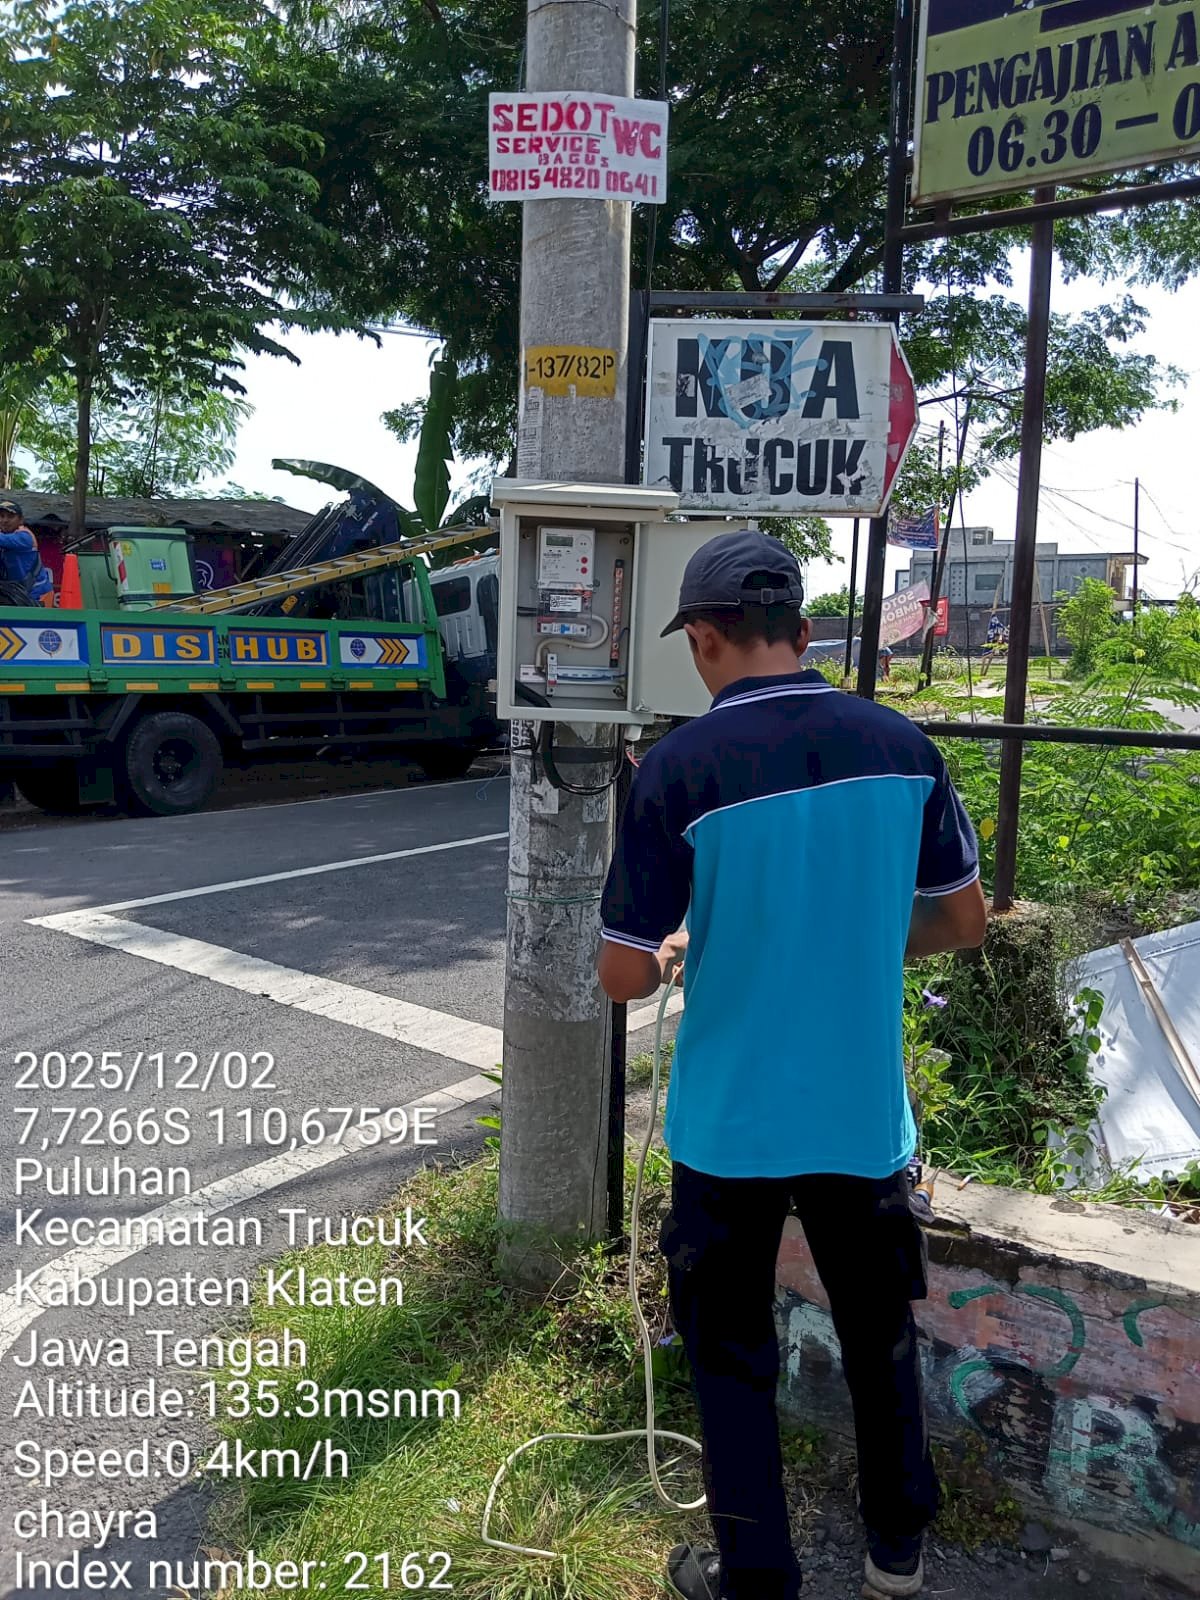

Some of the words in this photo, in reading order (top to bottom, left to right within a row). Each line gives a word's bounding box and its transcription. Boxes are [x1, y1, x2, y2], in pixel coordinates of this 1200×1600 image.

[925, 20, 1157, 124] PENGAJIAN
[492, 102, 616, 133] SEDOT
[612, 117, 662, 159] WC
[496, 136, 600, 154] SERVICE
[967, 102, 1102, 177] 06.30
[538, 153, 609, 168] BAGUS
[111, 633, 202, 659] DIS
[236, 636, 318, 660] HUB
